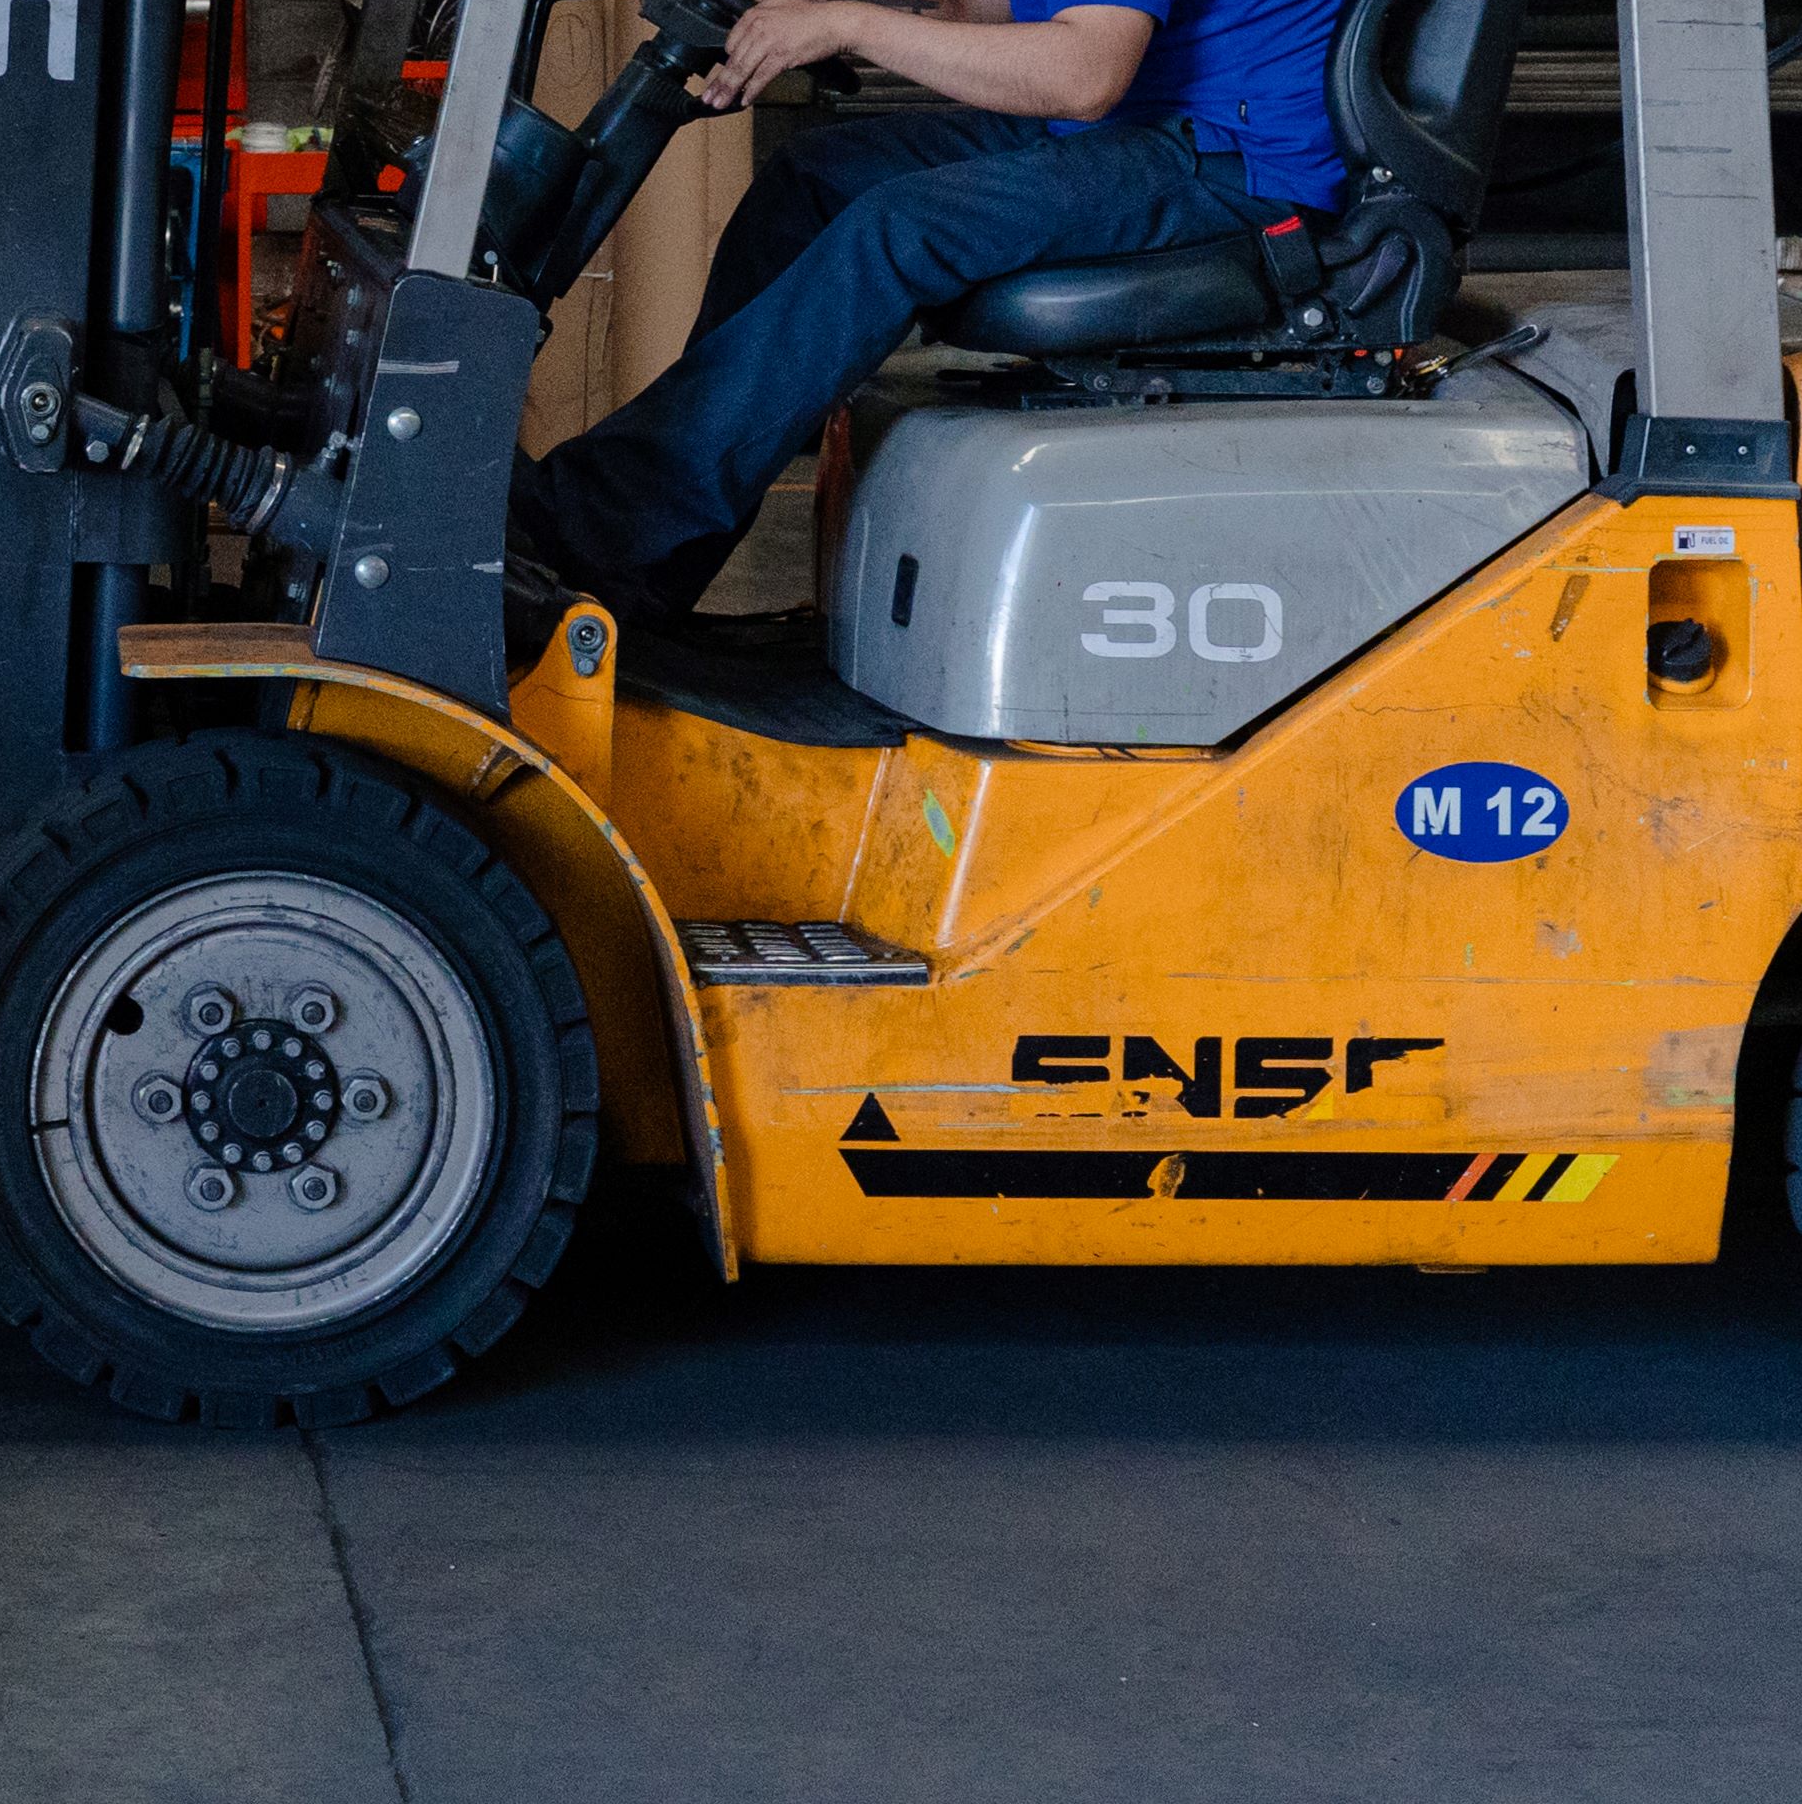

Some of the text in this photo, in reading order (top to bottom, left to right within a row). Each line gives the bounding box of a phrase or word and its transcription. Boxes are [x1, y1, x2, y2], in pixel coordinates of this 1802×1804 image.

[1701, 536, 1716, 545] FUEL
[1080, 581, 1283, 663] 30
[1412, 787, 1558, 837] M 12
